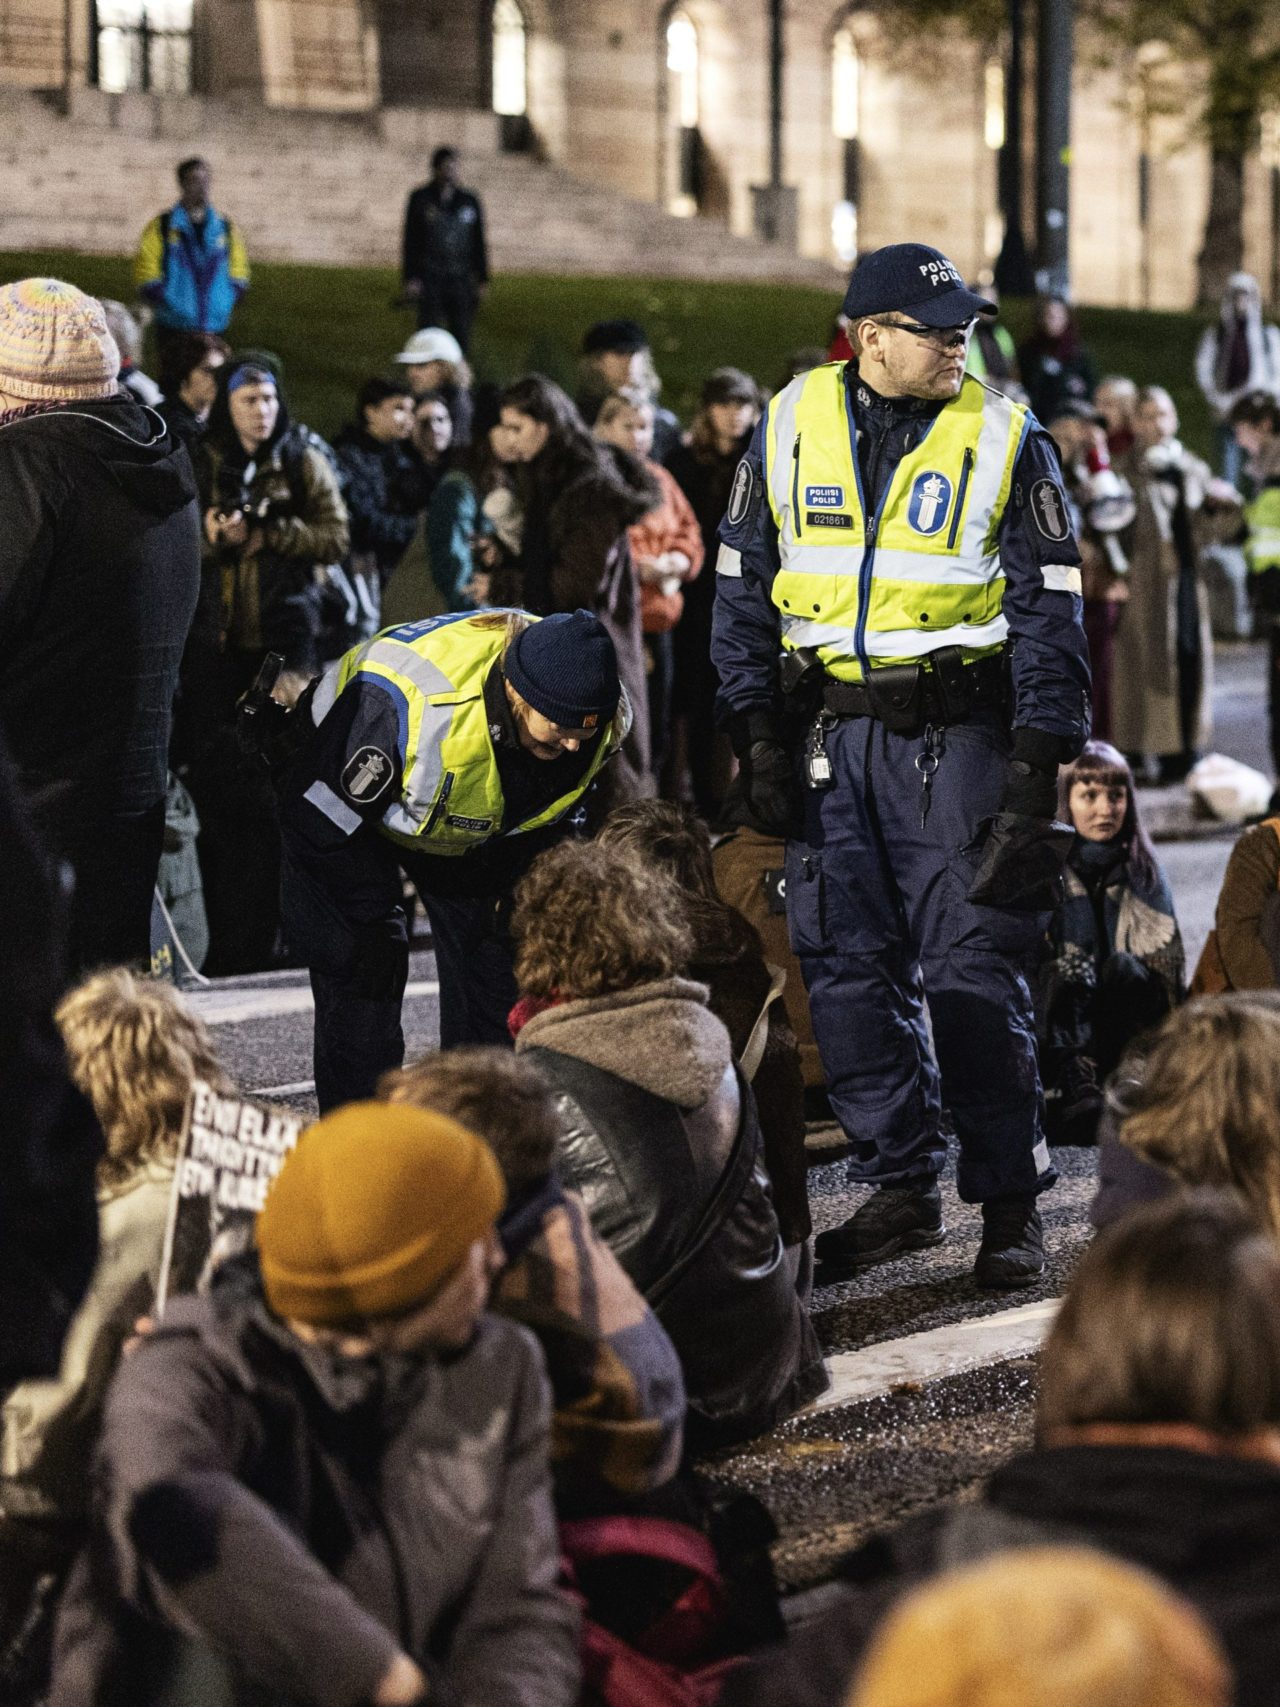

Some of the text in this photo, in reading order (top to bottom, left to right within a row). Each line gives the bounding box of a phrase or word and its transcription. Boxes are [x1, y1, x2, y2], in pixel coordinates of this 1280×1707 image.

[919, 259, 957, 276] POLI
[809, 488, 839, 496] POLIISI
[814, 514, 845, 526] 021861
